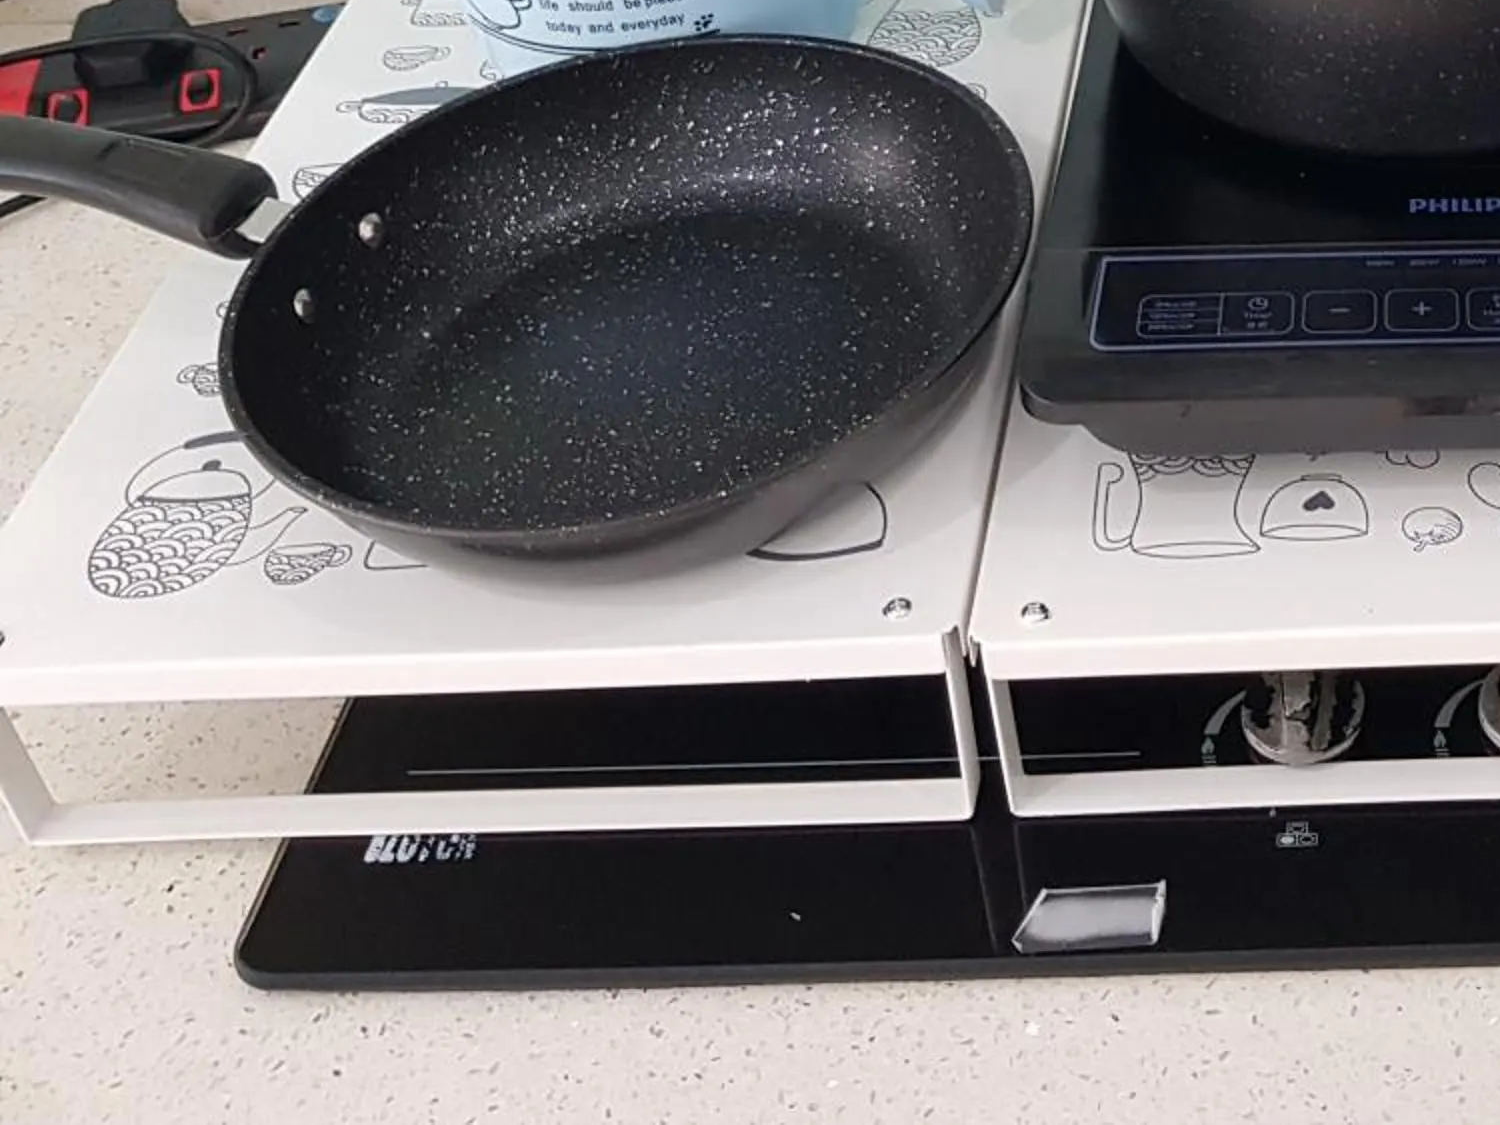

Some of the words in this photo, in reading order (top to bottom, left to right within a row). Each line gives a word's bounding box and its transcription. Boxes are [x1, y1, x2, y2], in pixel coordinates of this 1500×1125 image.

[568, 0, 615, 12] should
[545, 20, 582, 36] today
[589, 21, 615, 34] and
[621, 13, 686, 32] everyday
